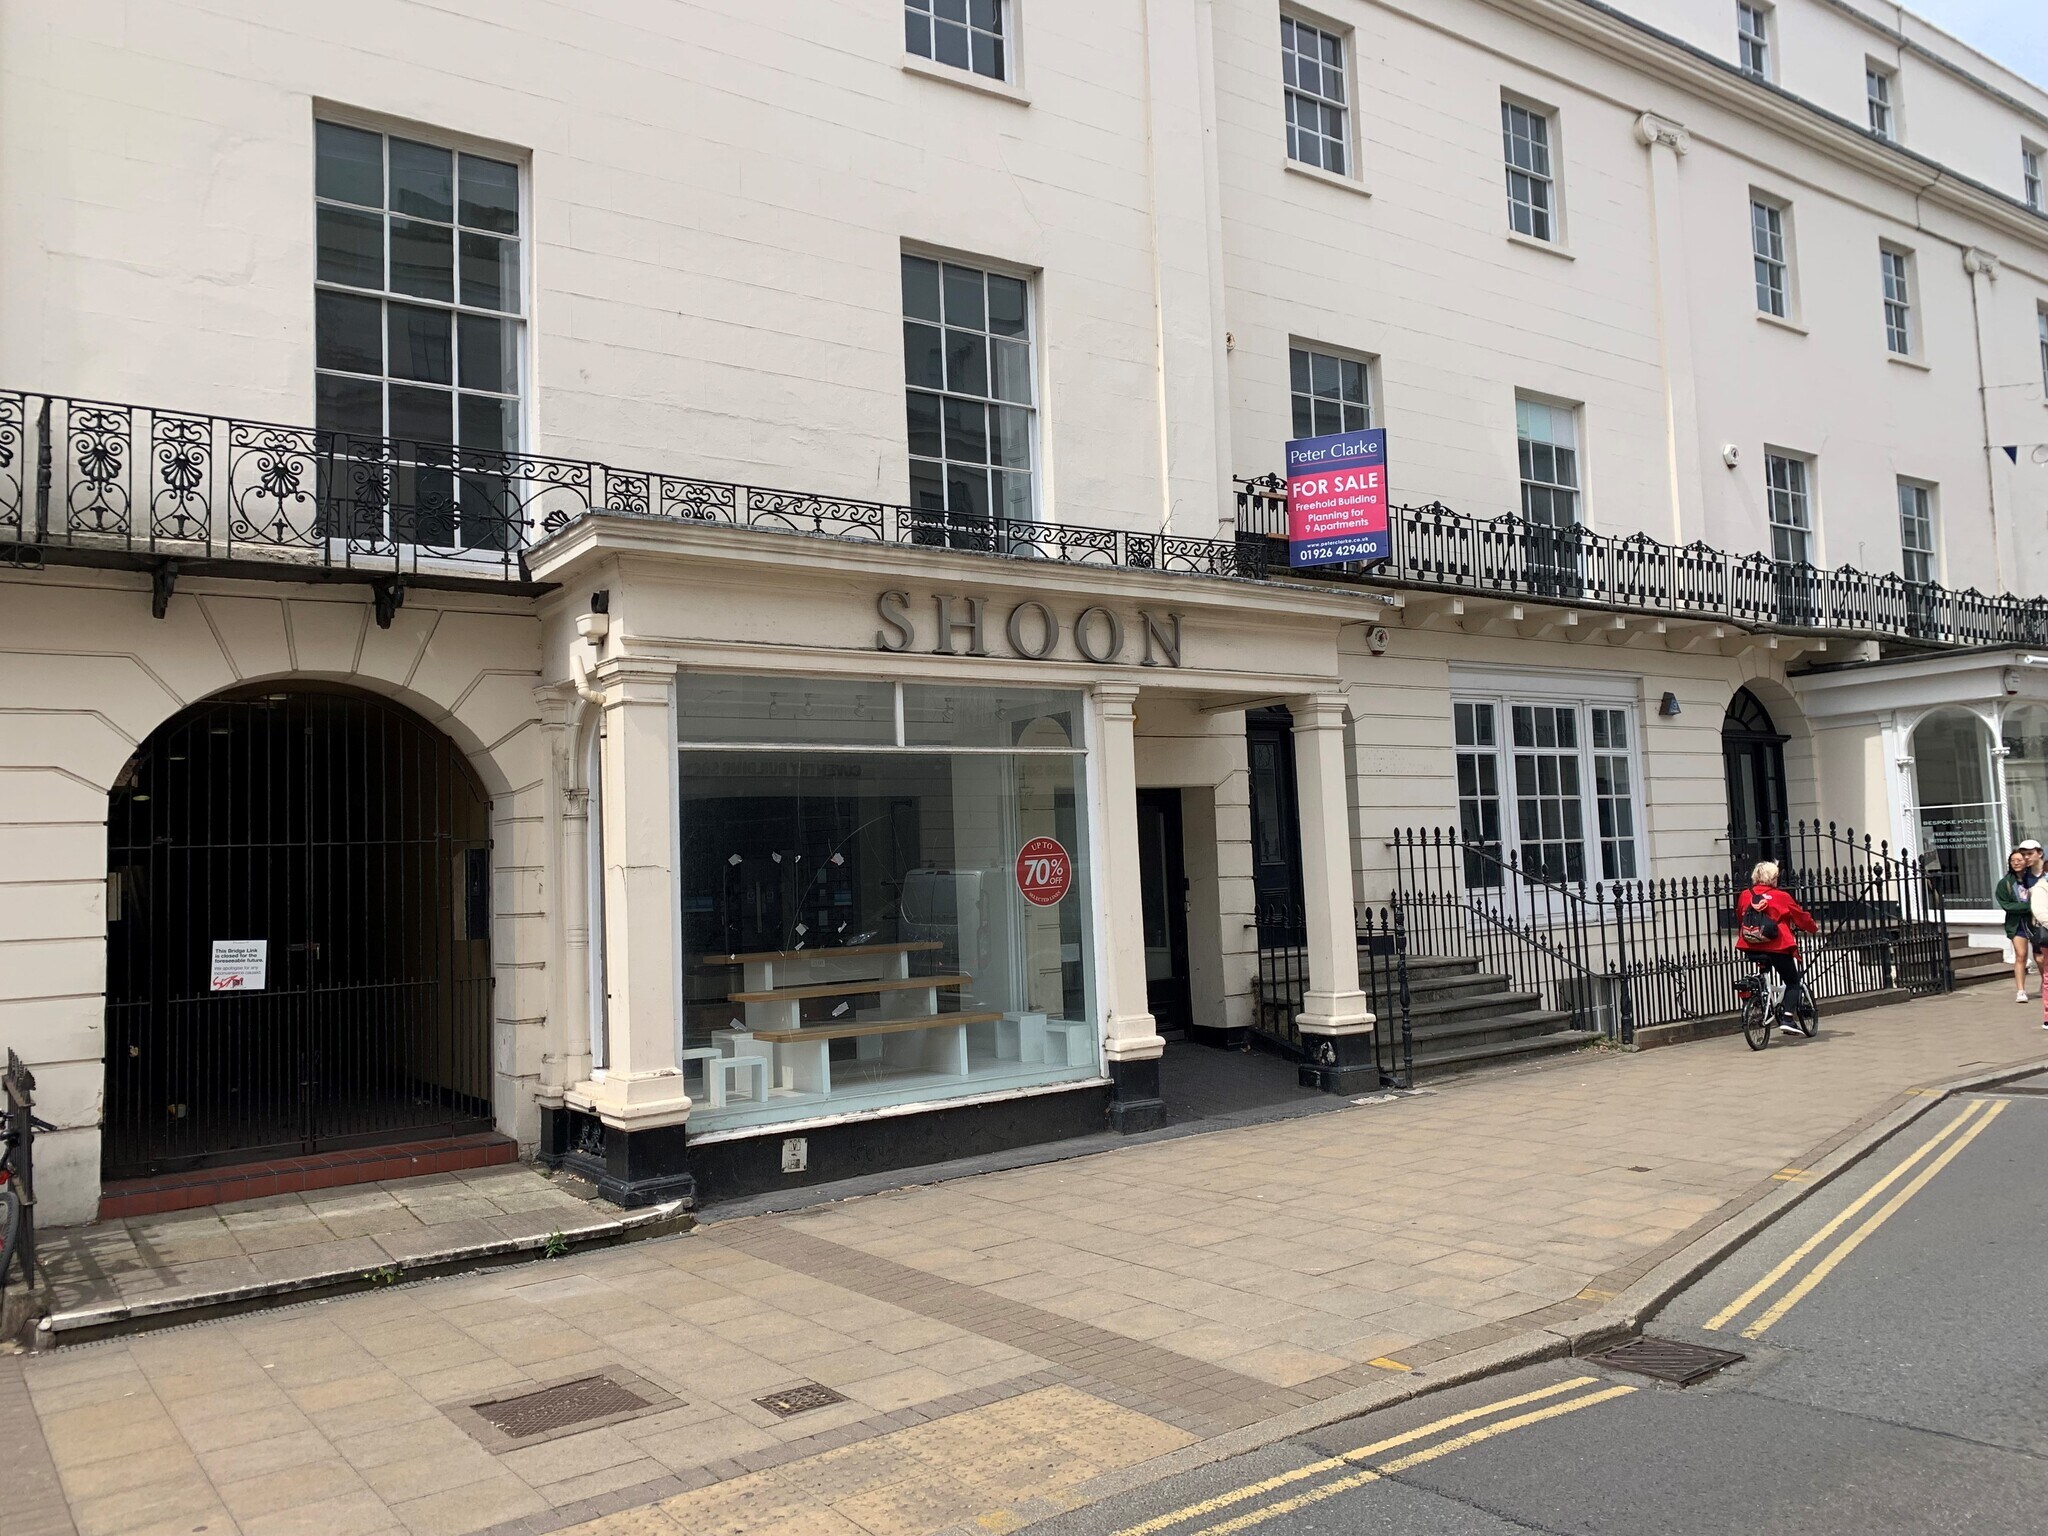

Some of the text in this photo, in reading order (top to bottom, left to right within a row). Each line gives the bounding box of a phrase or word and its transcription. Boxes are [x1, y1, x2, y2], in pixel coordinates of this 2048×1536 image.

[1290, 440, 1378, 464] Peter Clarke
[1292, 472, 1378, 498] FOR SALE
[1295, 495, 1377, 512] Freehold Building
[1307, 508, 1364, 522] Planning for
[1305, 518, 1369, 533] 9 Apartments
[1307, 537, 1369, 548] www.peterclarke.co.uk
[1300, 542, 1377, 560] 01926 429400
[876, 589, 1186, 668] SHOON
[1031, 842, 1053, 851] UP TO
[1024, 858, 1064, 886] 70%
[1049, 876, 1063, 885] OFF
[1029, 890, 1061, 902] SELECTED LINES
